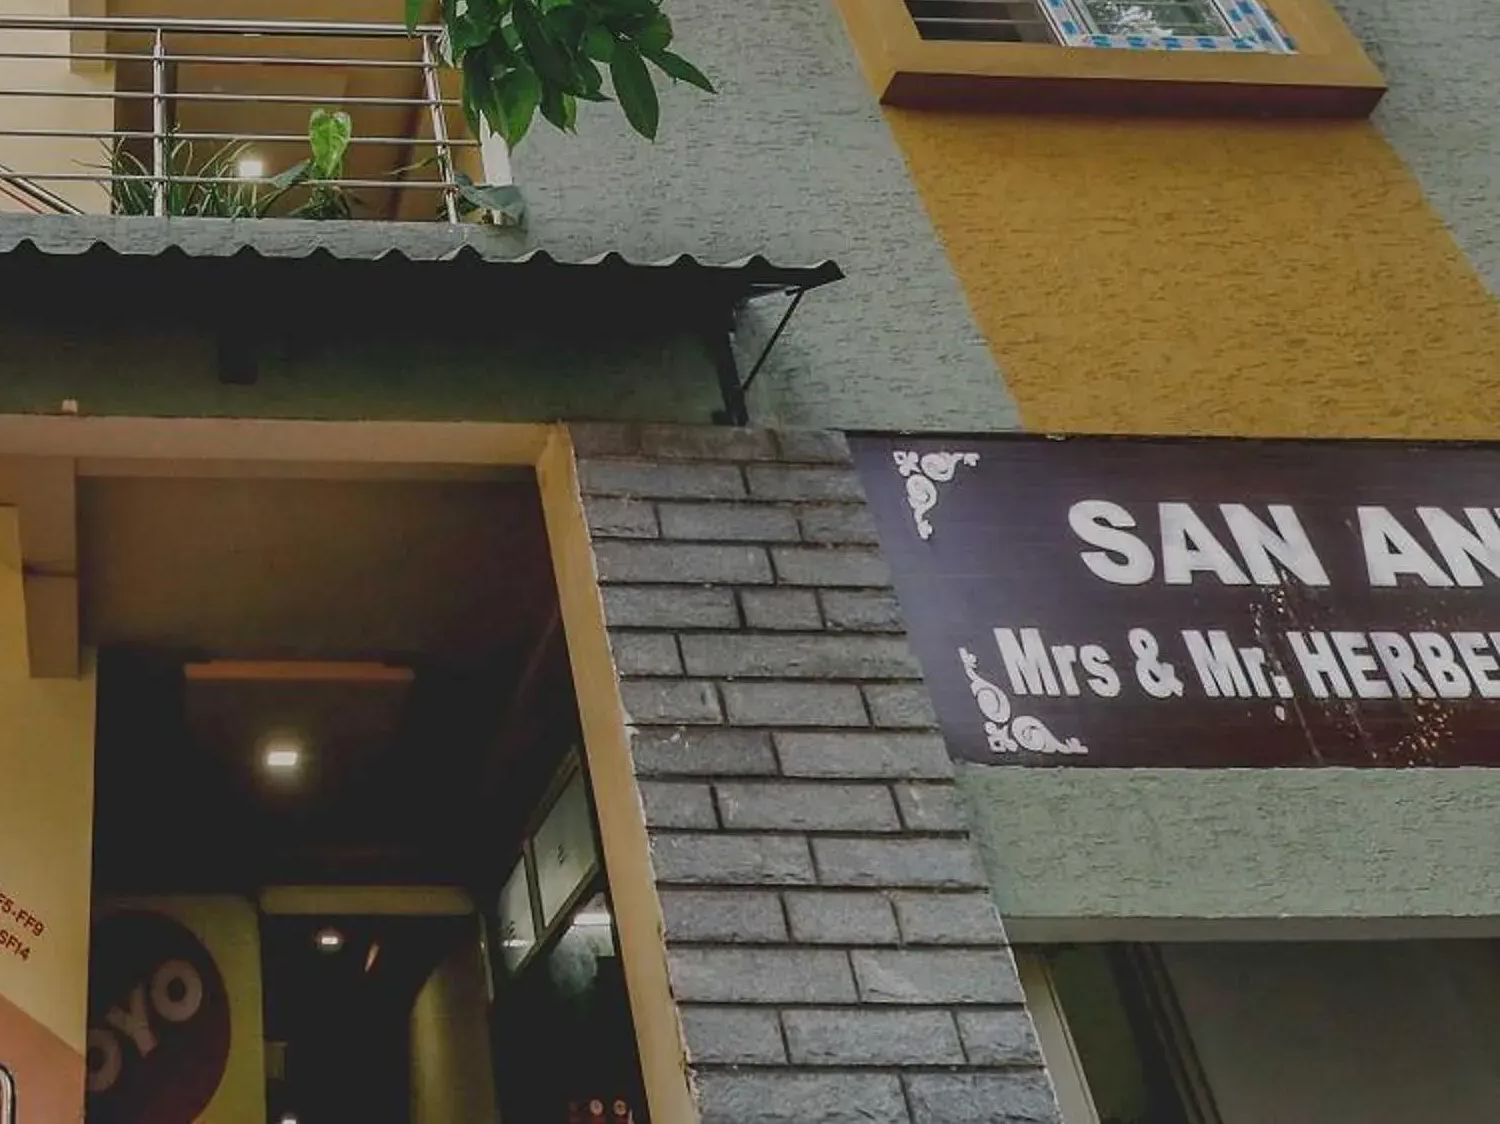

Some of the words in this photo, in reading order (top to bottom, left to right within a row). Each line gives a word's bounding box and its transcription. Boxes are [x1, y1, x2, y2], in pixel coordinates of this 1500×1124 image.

[1067, 500, 1330, 585] SAN
[1356, 505, 1500, 587] AN
[993, 626, 1122, 698] Mrs
[1127, 627, 1184, 699] &
[1286, 630, 1500, 699] HERBE
[85, 959, 203, 1093] OYO
